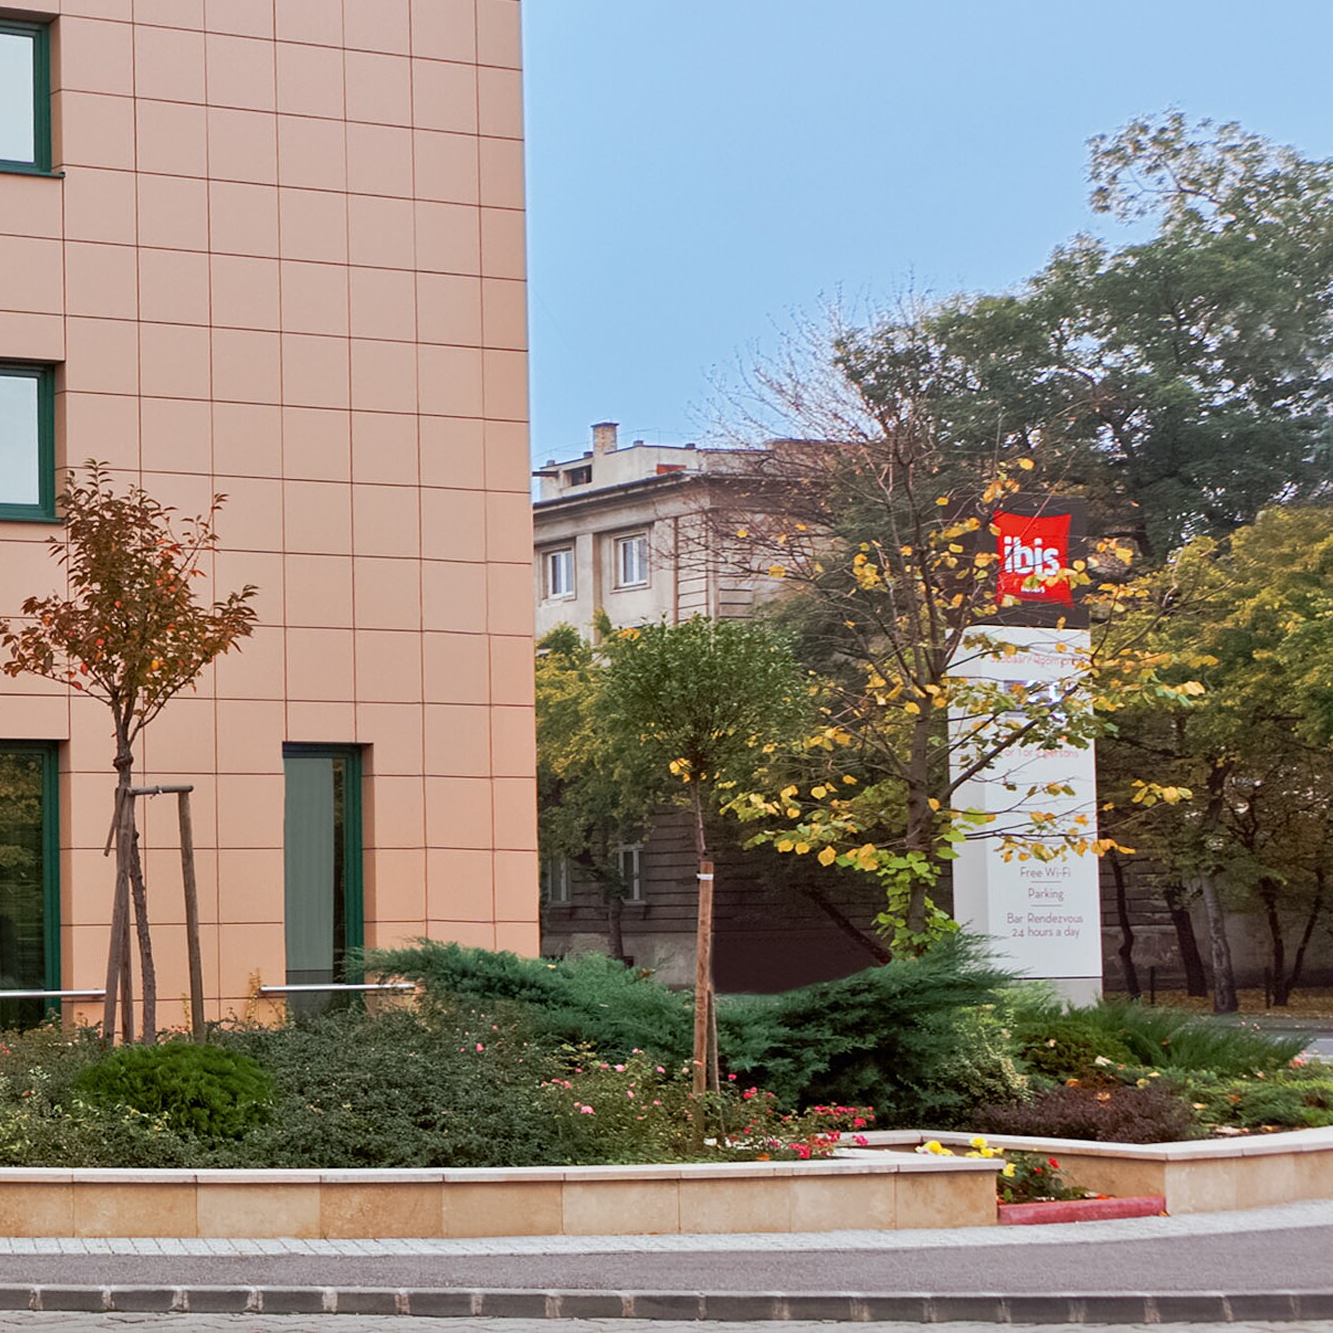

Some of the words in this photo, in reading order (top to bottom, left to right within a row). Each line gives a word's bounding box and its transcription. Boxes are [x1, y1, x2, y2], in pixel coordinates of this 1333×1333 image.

[1003, 536, 1060, 576] ibis
[1020, 866, 1043, 878] Free
[1045, 866, 1071, 877] Wi-Fi
[1028, 887, 1064, 902] Parking
[1007, 912, 1024, 924] Bar
[1027, 912, 1083, 924] Rendezvous
[1012, 928, 1024, 937] 24
[1027, 927, 1053, 937] hours
[1063, 926, 1081, 939] day
